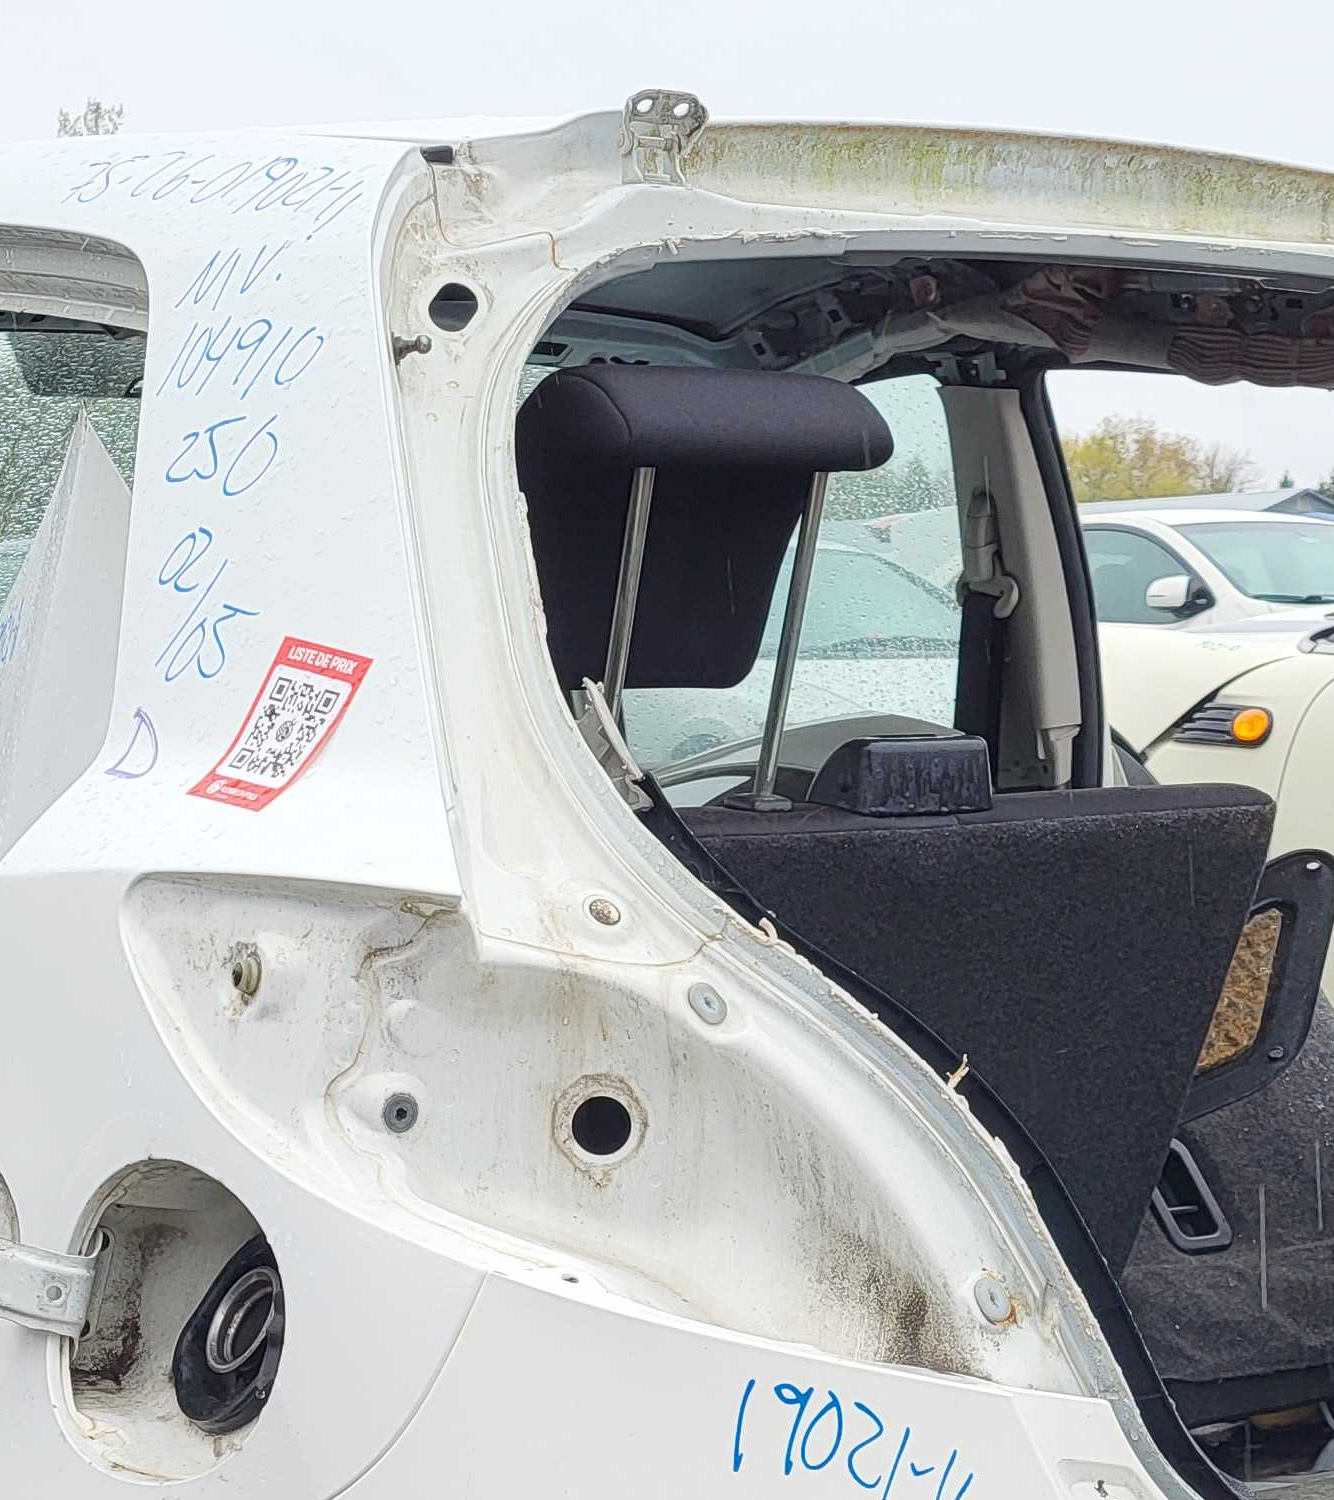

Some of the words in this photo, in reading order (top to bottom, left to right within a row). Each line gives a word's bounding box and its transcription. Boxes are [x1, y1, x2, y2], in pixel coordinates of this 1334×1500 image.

[157, 315, 325, 401] 104910
[166, 413, 279, 497] 250
[287, 645, 318, 664] LISTE
[315, 652, 333, 668] DE
[329, 656, 359, 675] PRIX
[104, 706, 159, 779] D
